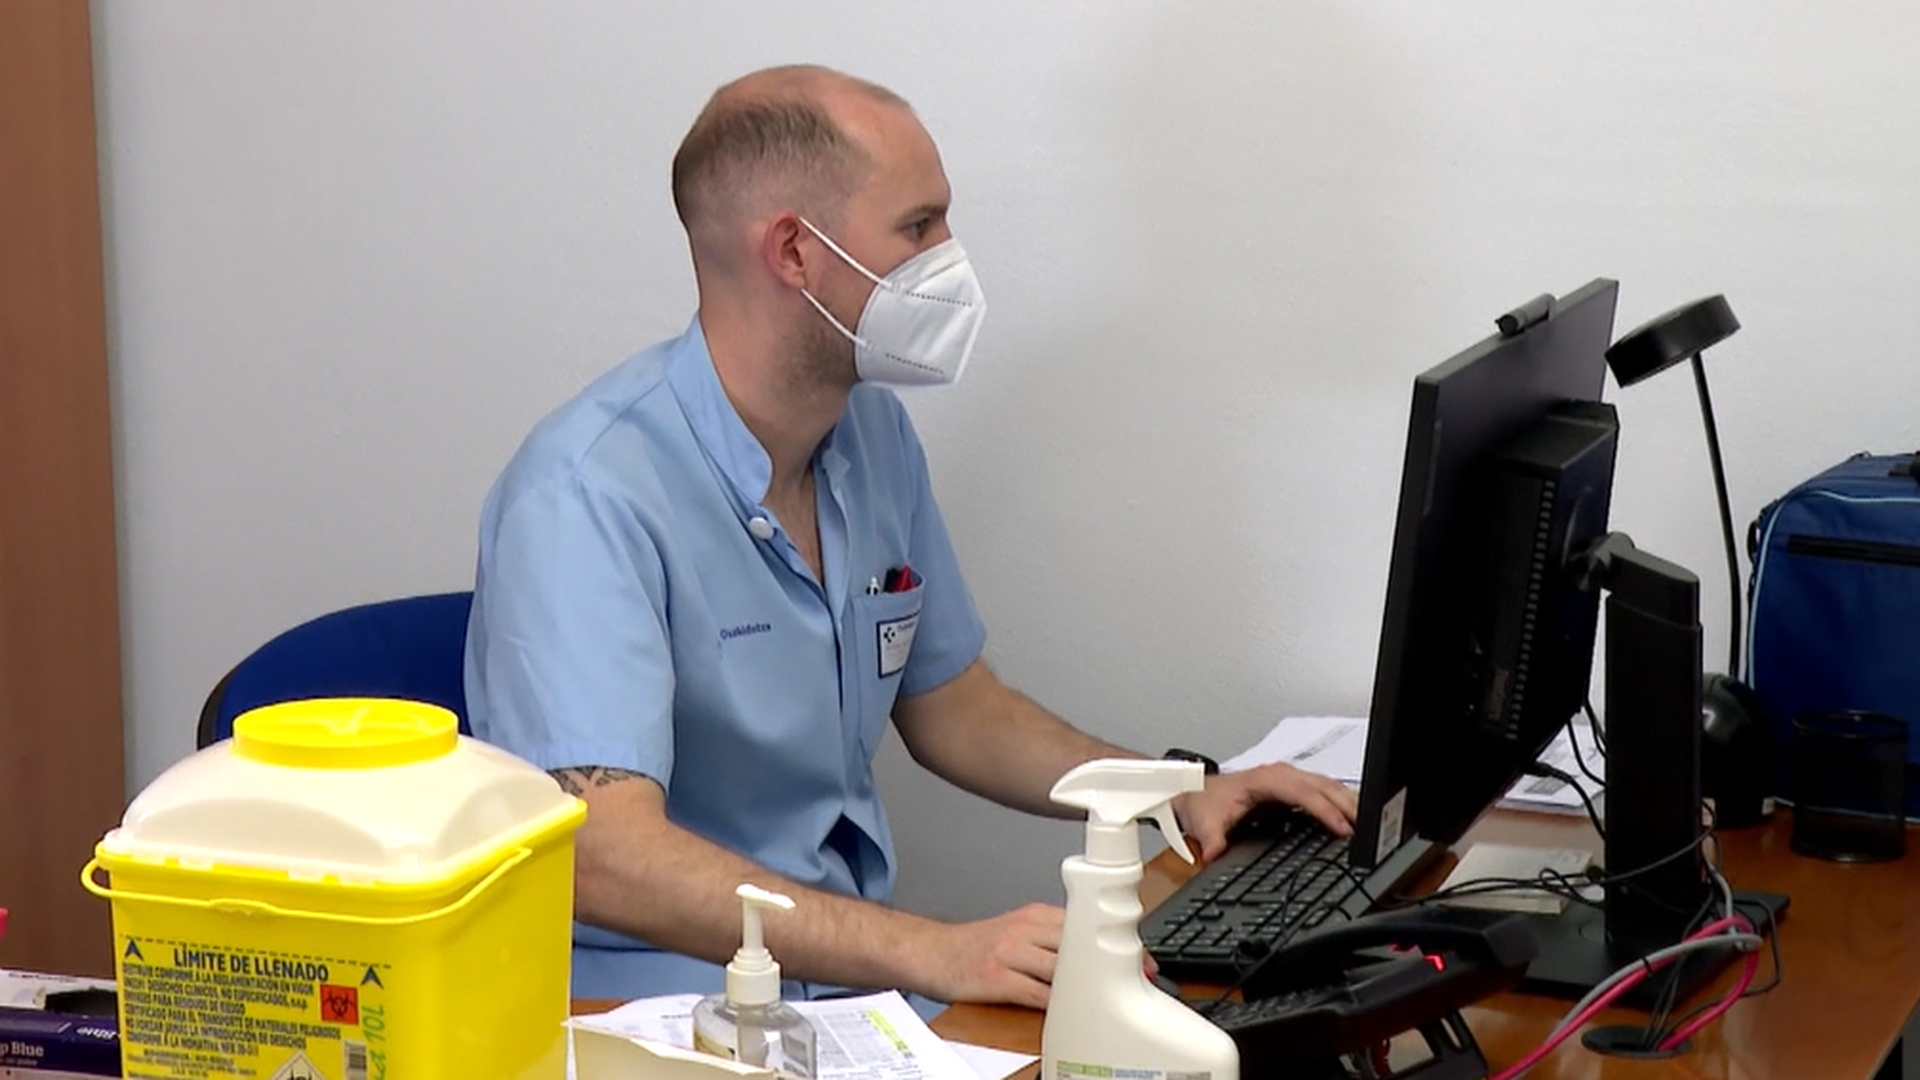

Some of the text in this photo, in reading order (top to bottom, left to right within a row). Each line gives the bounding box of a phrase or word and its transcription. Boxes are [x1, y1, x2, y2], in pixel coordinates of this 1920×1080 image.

[173, 943, 329, 982] LÍMITE DE LLENADO
[202, 972, 211, 983] LA
[280, 981, 290, 992] EN
[292, 982, 313, 995] VIGOR
[220, 987, 231, 999] NO
[153, 993, 171, 1006] PARA
[210, 1000, 217, 1011] DE
[168, 1008, 186, 1021] PARA
[188, 1011, 196, 1022] EL
[198, 1012, 242, 1027] TRANSPORTE
[244, 1017, 253, 1029] DE
[255, 1018, 296, 1034] MATERIALES
[299, 1024, 341, 1039] PELIGROSOS
[189, 1024, 198, 1036] LA
[258, 1032, 268, 1044] DE
[11, 1041, 45, 1057] Blue
